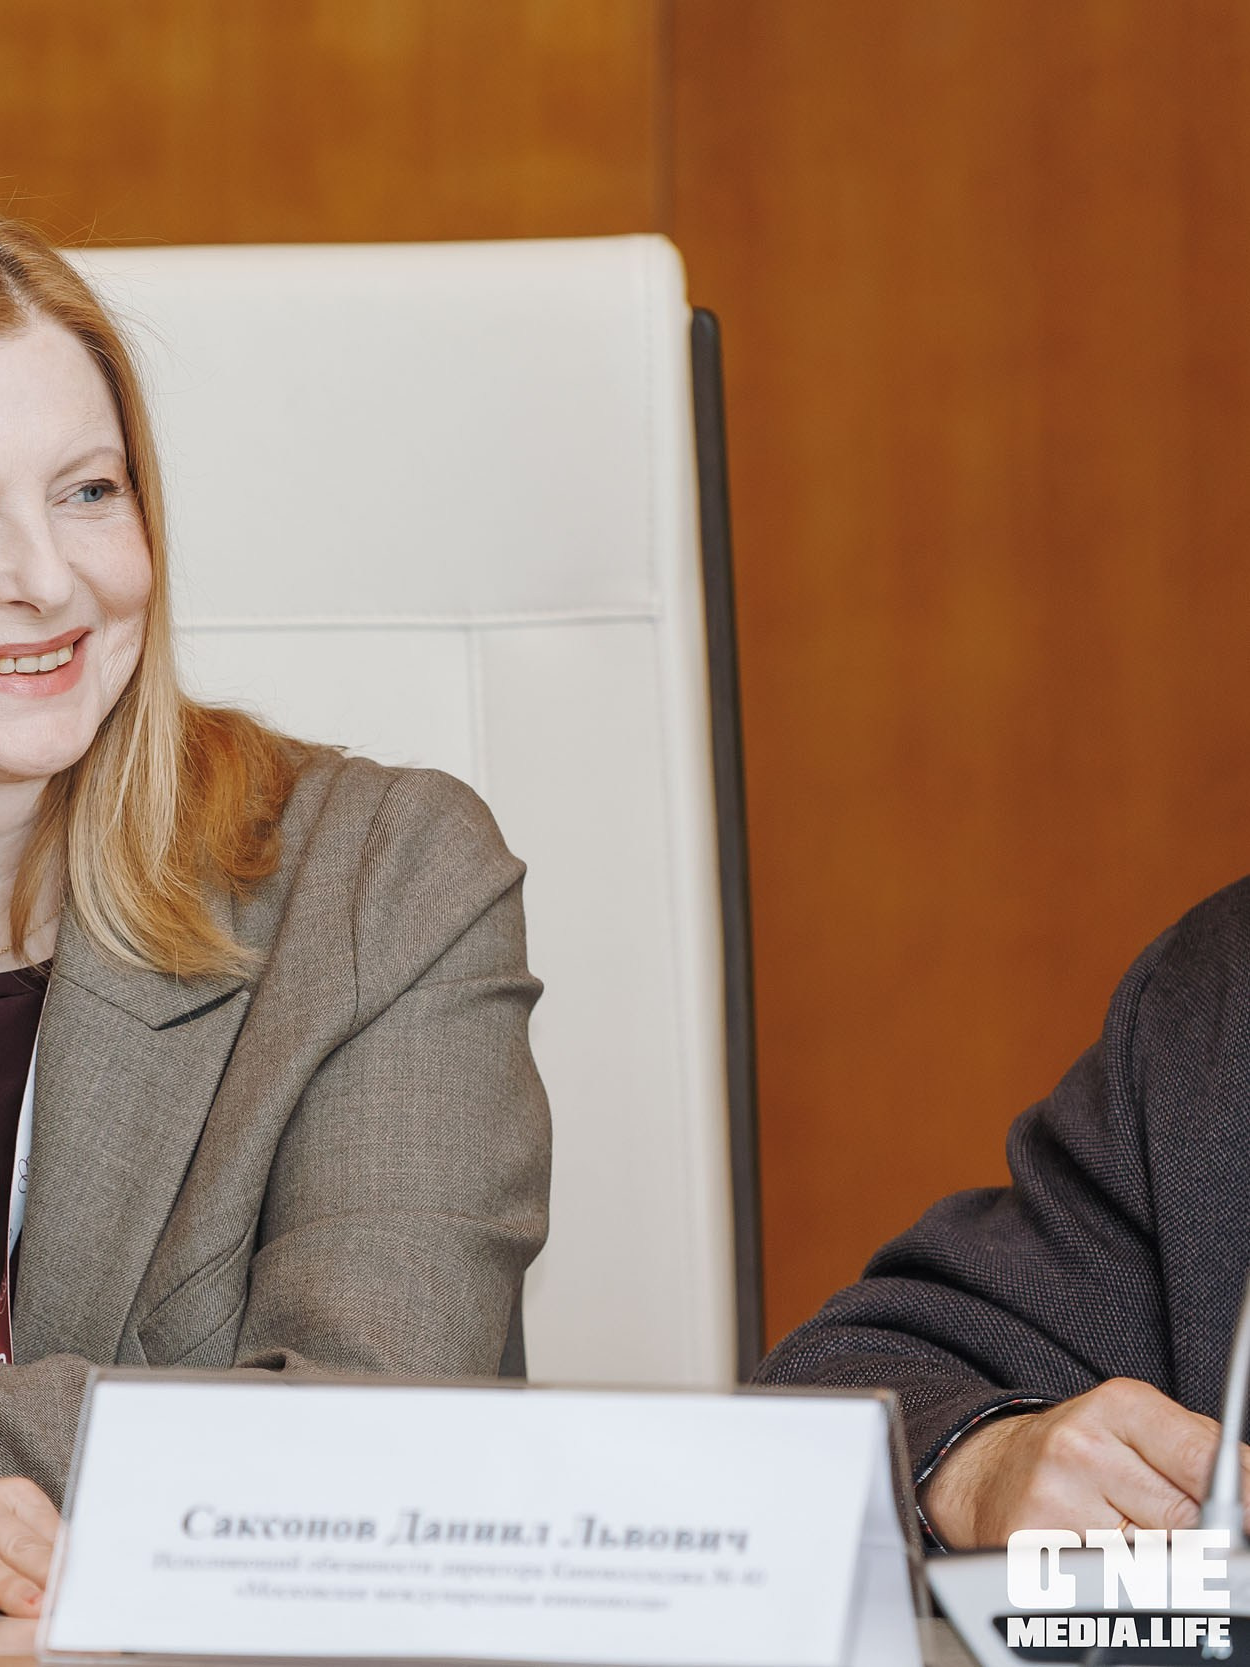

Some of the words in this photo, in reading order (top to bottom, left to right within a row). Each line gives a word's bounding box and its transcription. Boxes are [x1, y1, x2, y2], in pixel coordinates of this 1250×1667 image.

[180, 1504, 377, 1542] Саксонов
[385, 1510, 549, 1550] Даниил
[560, 1515, 749, 1555] Львович
